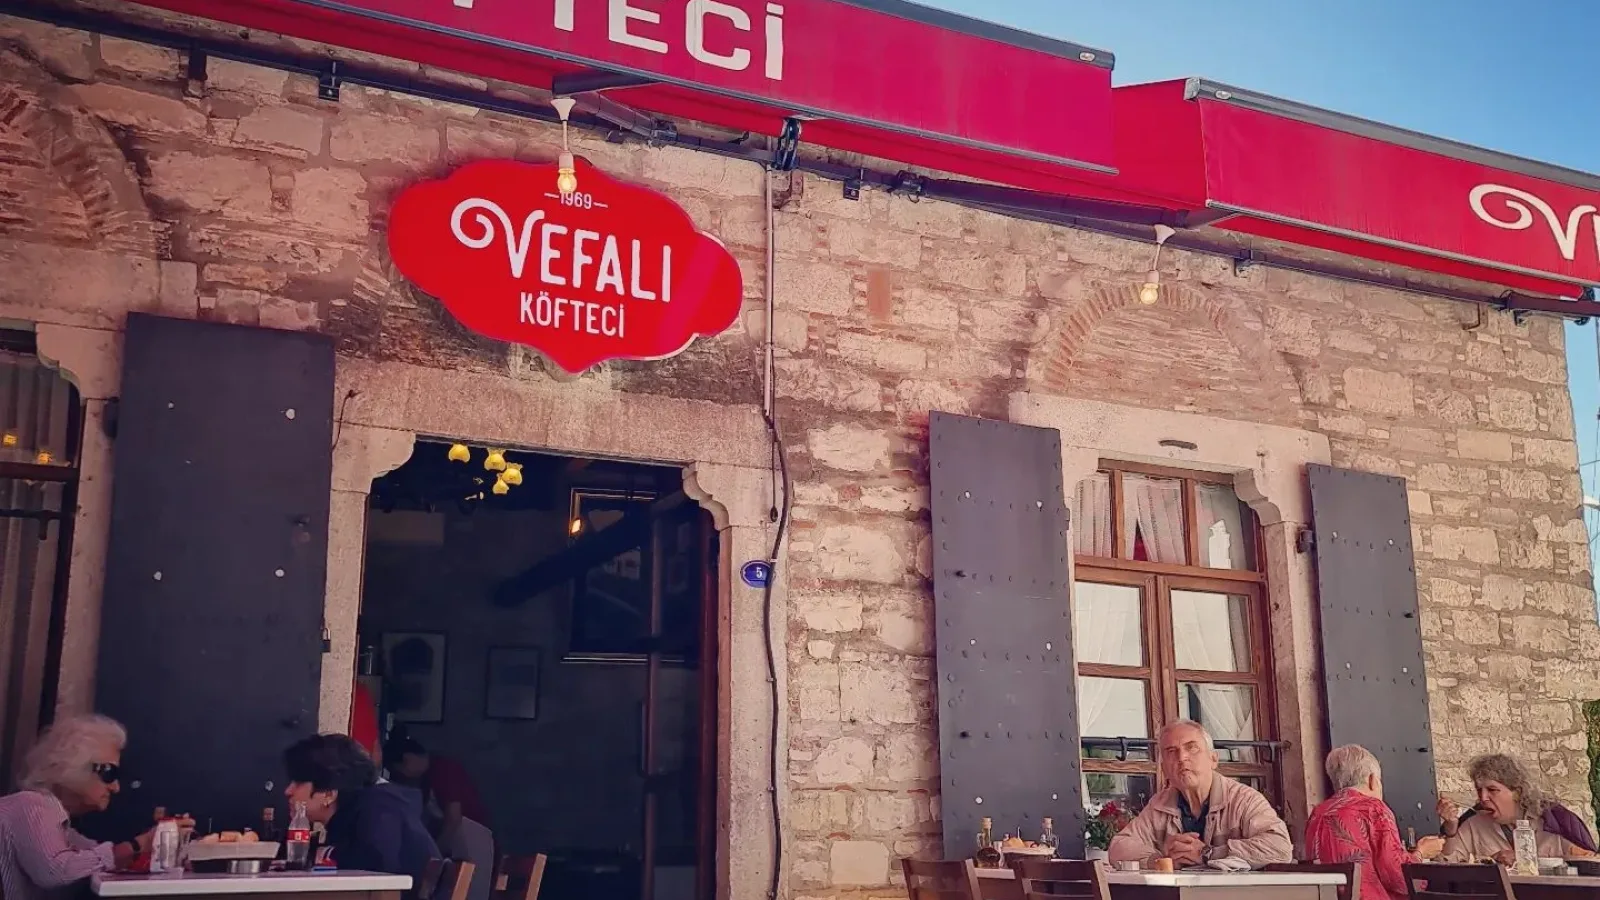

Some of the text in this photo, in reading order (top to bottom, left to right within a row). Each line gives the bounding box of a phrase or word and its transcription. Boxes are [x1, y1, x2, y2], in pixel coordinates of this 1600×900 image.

[560, 191, 592, 210] 1969
[1468, 183, 1600, 261] V
[450, 198, 672, 302] VEFALI
[520, 290, 625, 338] KÖFTECİ
[756, 566, 763, 579] 5
